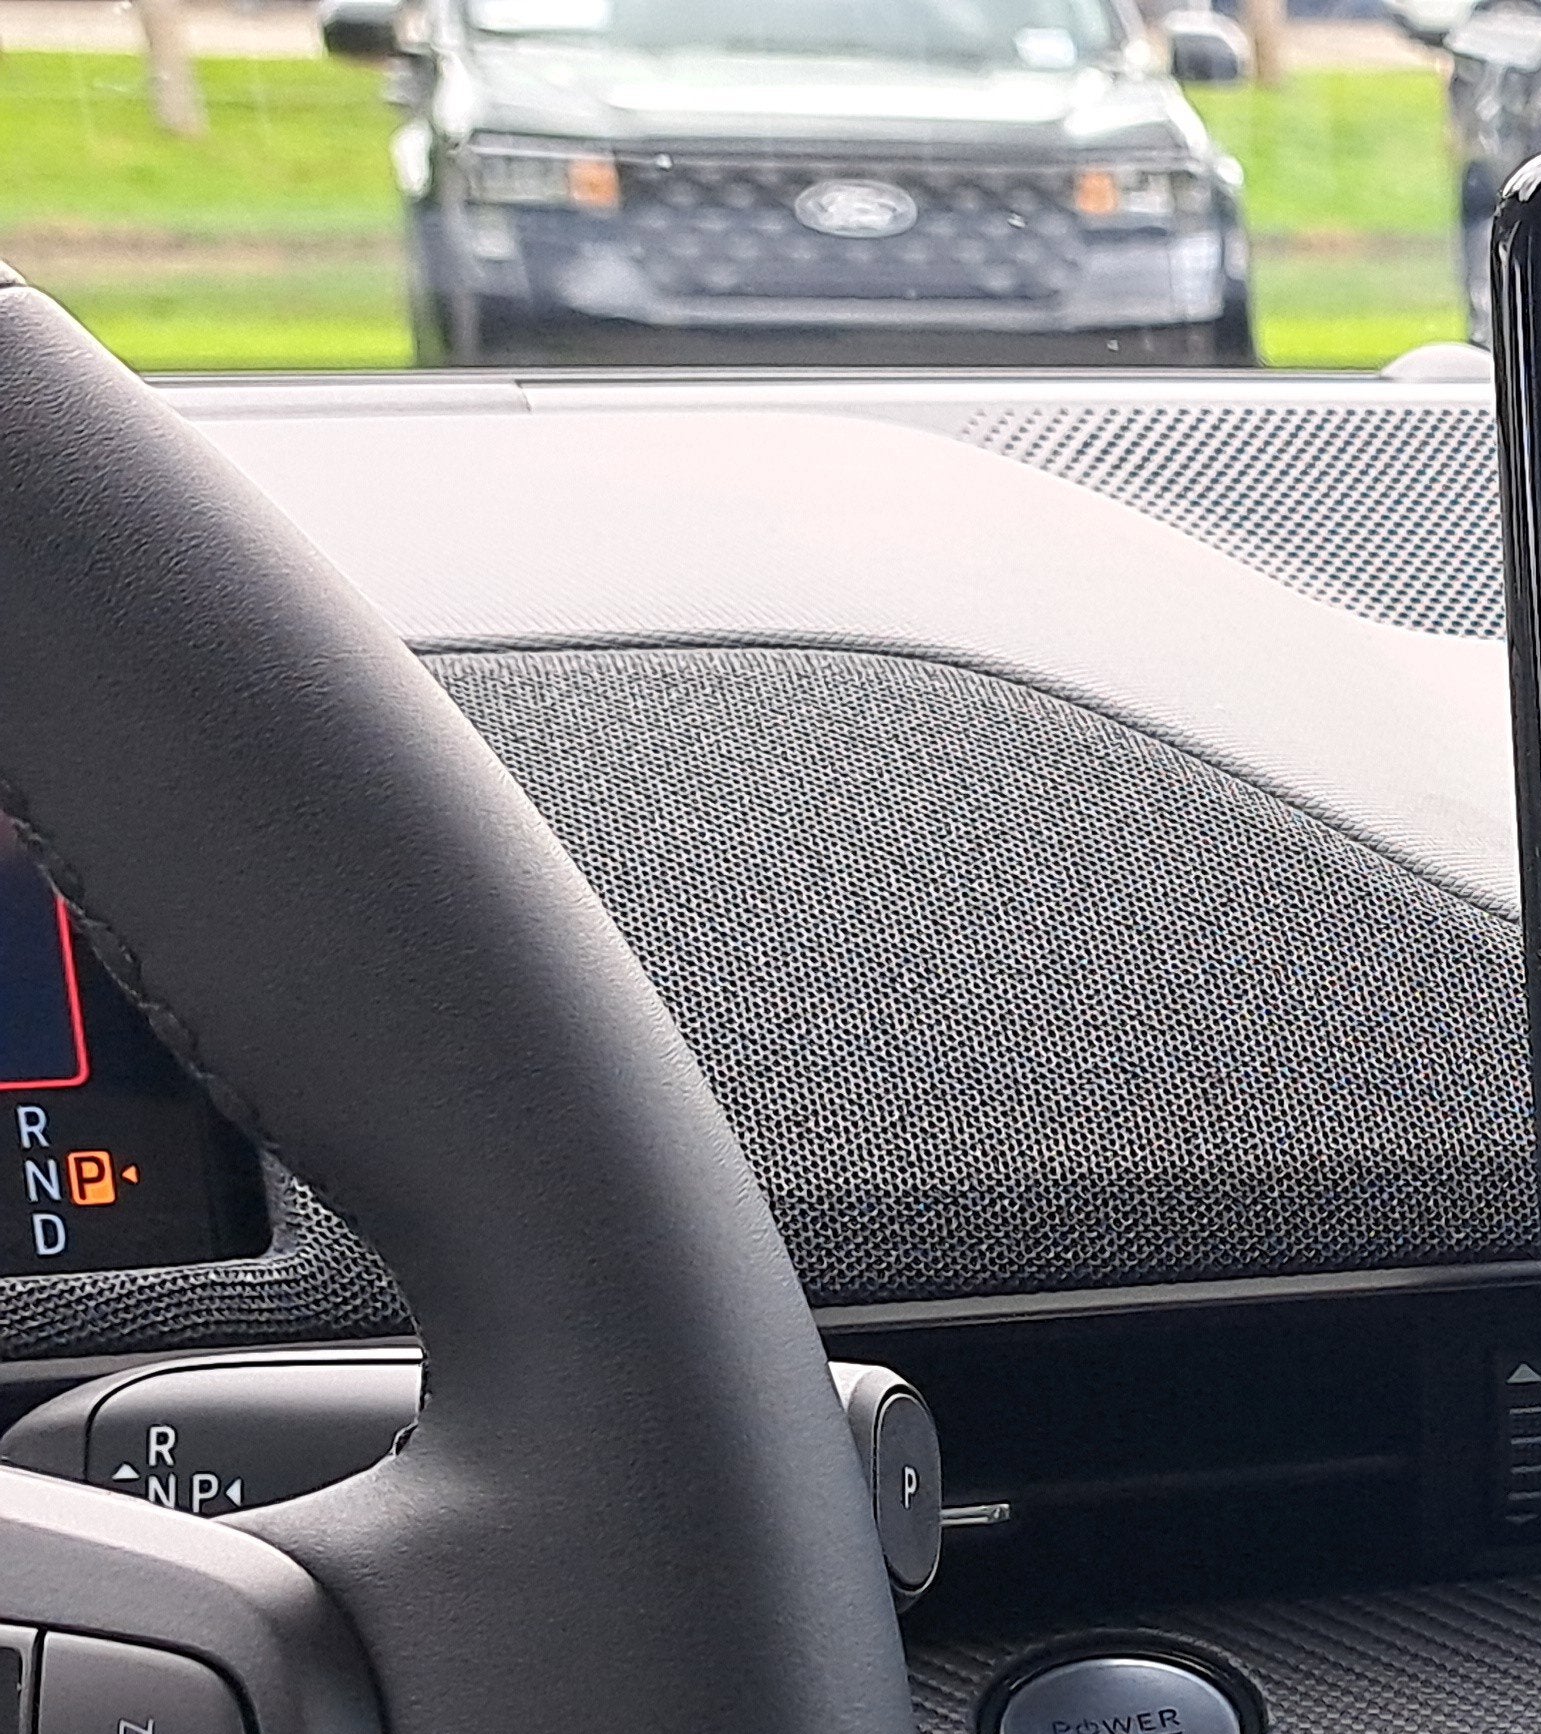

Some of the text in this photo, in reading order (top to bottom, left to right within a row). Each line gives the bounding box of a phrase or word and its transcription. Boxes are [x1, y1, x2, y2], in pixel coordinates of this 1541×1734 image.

[17, 1105, 50, 1149] R
[24, 1155, 106, 1201] N P
[32, 1212, 66, 1256] D
[148, 1426, 176, 1467] R
[146, 1474, 220, 1514] N P
[903, 1466, 918, 1508] P
